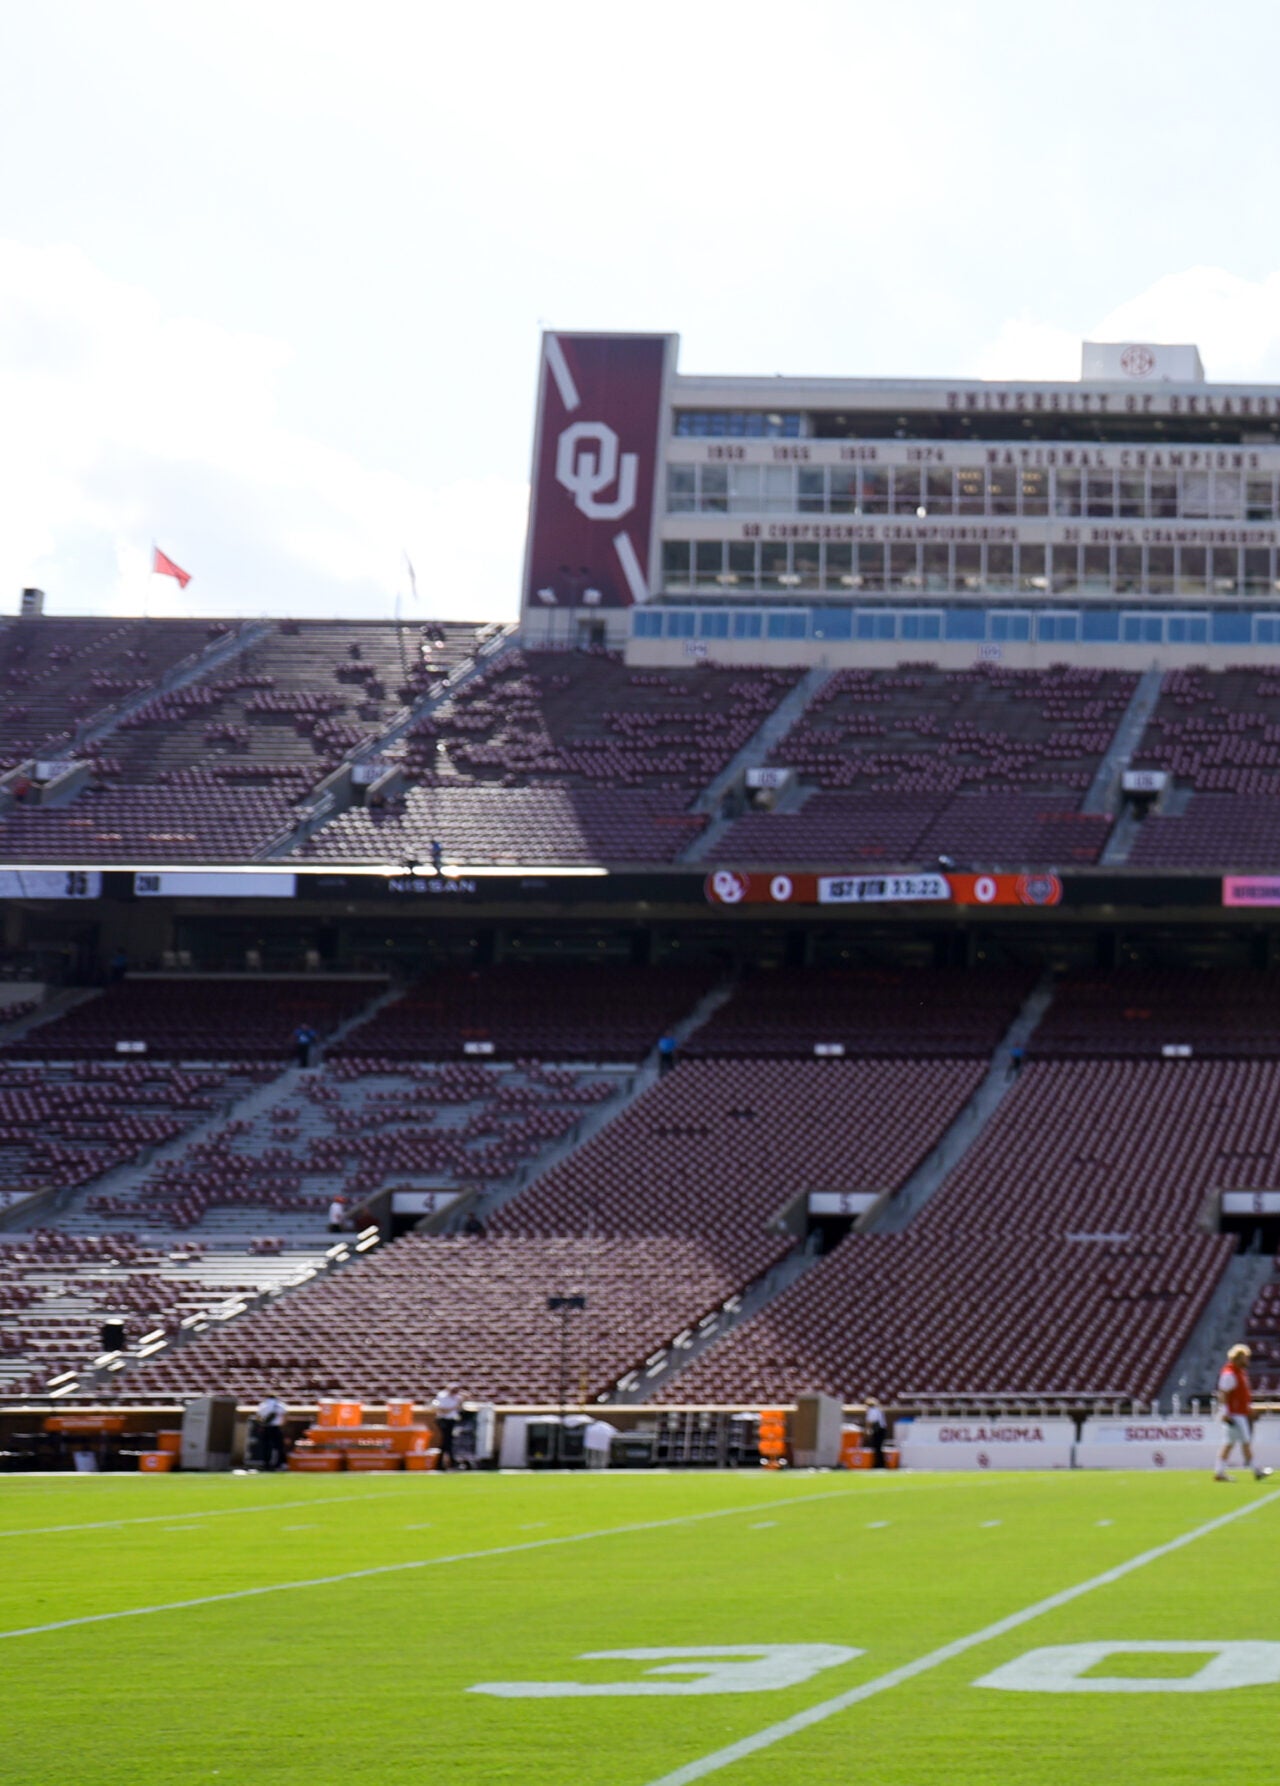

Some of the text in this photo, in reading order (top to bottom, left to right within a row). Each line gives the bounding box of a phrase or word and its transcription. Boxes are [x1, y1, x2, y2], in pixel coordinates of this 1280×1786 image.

[947, 391, 1109, 411] UNIVERSITY
[1125, 393, 1153, 412] OF
[986, 449, 1260, 468] NATIONAL CHAMPIONS
[555, 421, 640, 520] OU
[768, 524, 876, 539] CONFERENCE
[882, 525, 1019, 540] CHAMPIONSHIPS
[1091, 527, 1134, 542] BOWL
[1141, 528, 1276, 543] CHAMPIONSHIPS
[388, 879, 477, 893] NISSAN
[770, 875, 793, 901] 0
[973, 876, 997, 903] 0
[938, 1427, 1044, 1442] OKLAHOMA
[1125, 1425, 1205, 1441] SOONERS
